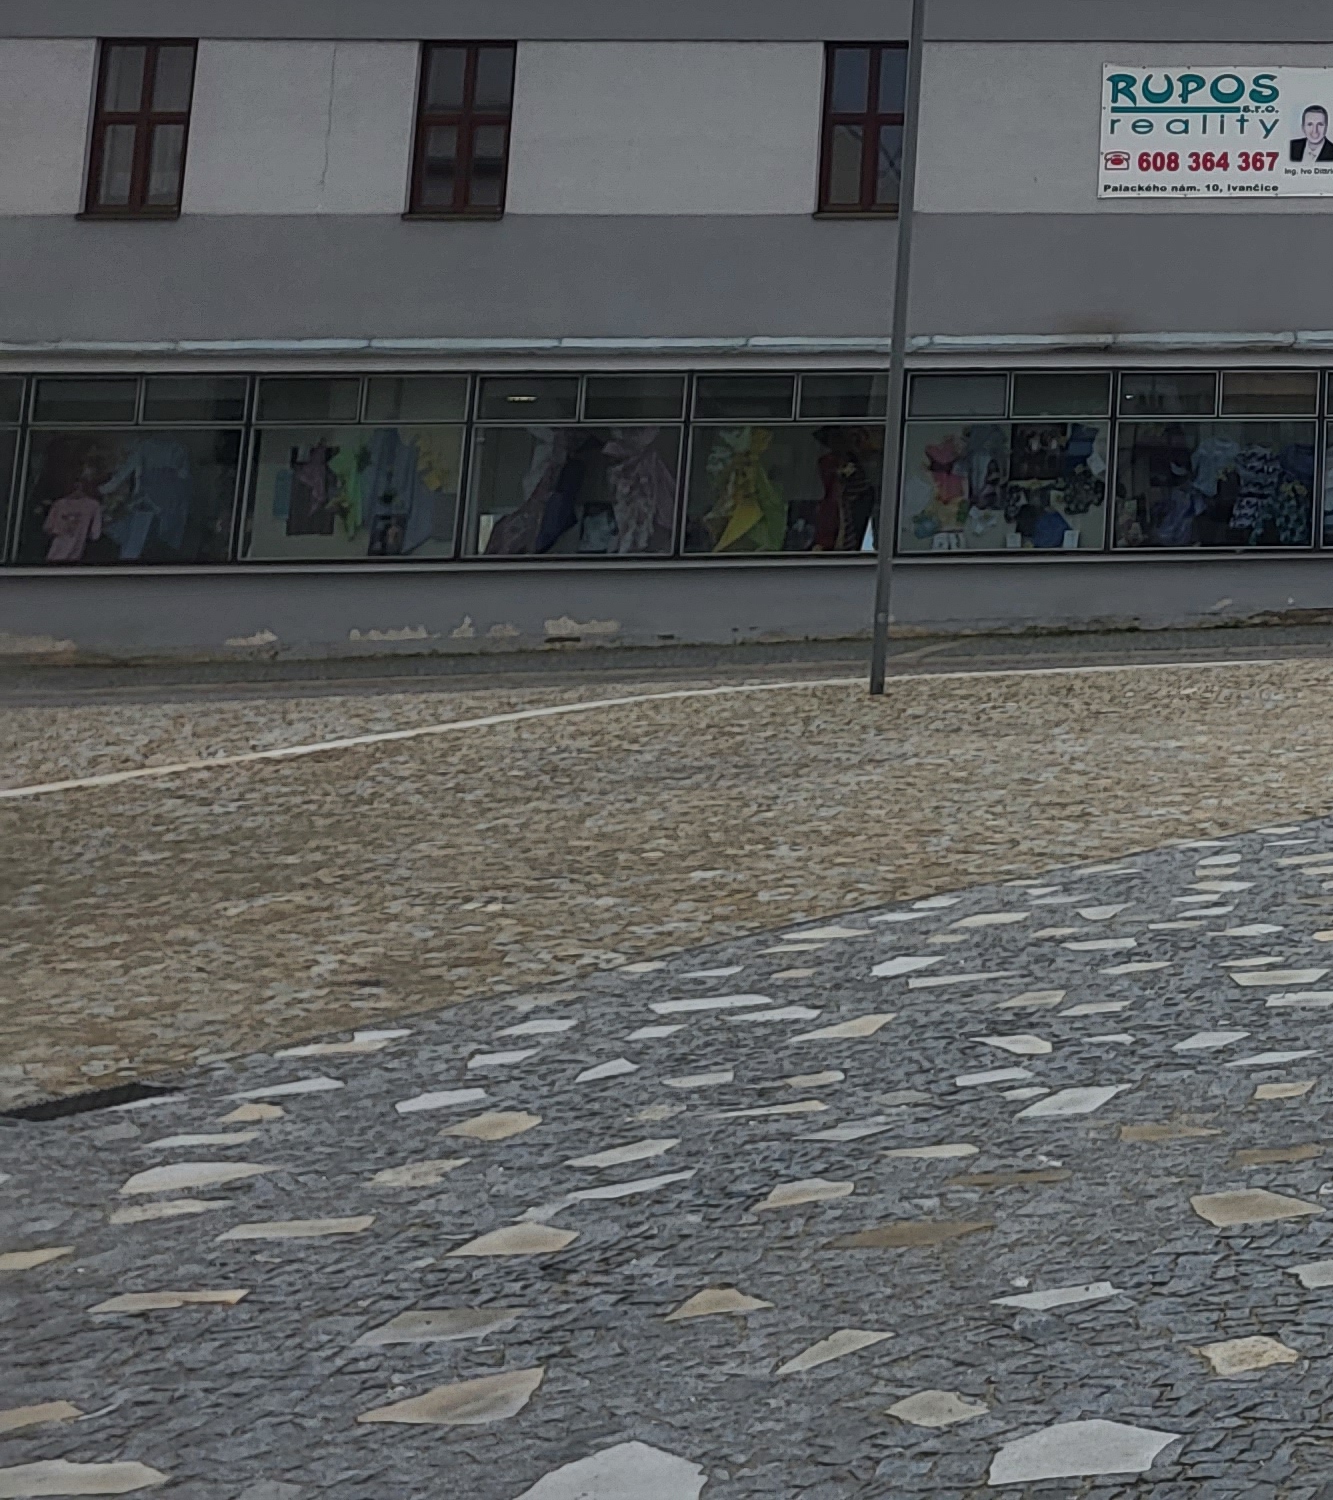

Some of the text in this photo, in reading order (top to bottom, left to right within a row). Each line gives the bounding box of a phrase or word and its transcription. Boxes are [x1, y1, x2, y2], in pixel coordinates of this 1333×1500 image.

[1106, 73, 1280, 106] RUPOS
[1242, 104, 1280, 114] s.r.o.
[1109, 114, 1280, 139] reality
[1137, 151, 1280, 172] 608 364 367
[1103, 183, 1279, 193] Palackého nám. 10, Ivančice
